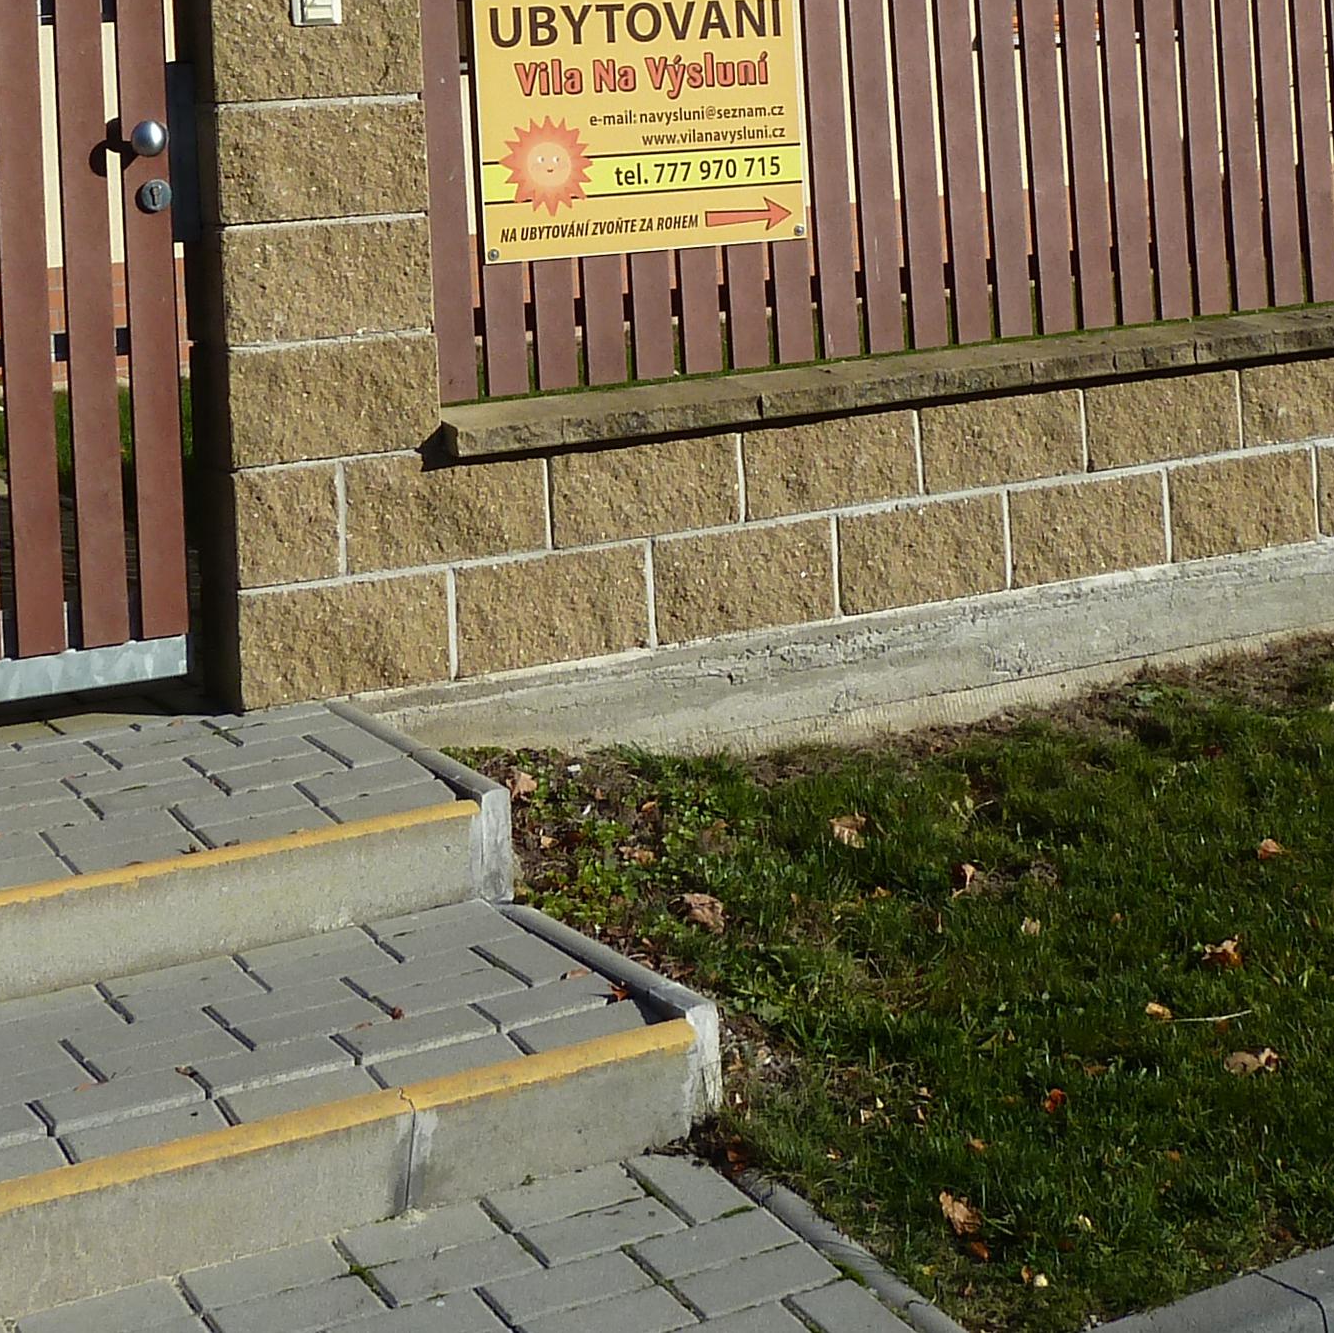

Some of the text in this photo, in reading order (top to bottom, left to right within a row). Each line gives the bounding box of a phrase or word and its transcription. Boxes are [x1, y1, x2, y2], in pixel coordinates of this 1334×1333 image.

[514, 51, 769, 99] Vila Na Výsluní
[589, 105, 785, 126] e-mail: navysluni@seznam.cz
[642, 125, 786, 146] www.vilanavysluni.cz
[615, 156, 781, 186] tel. 777 970 715
[500, 214, 699, 243] NA UBYTOVÁNÍ ZVOŇTE ZA ROHEM
